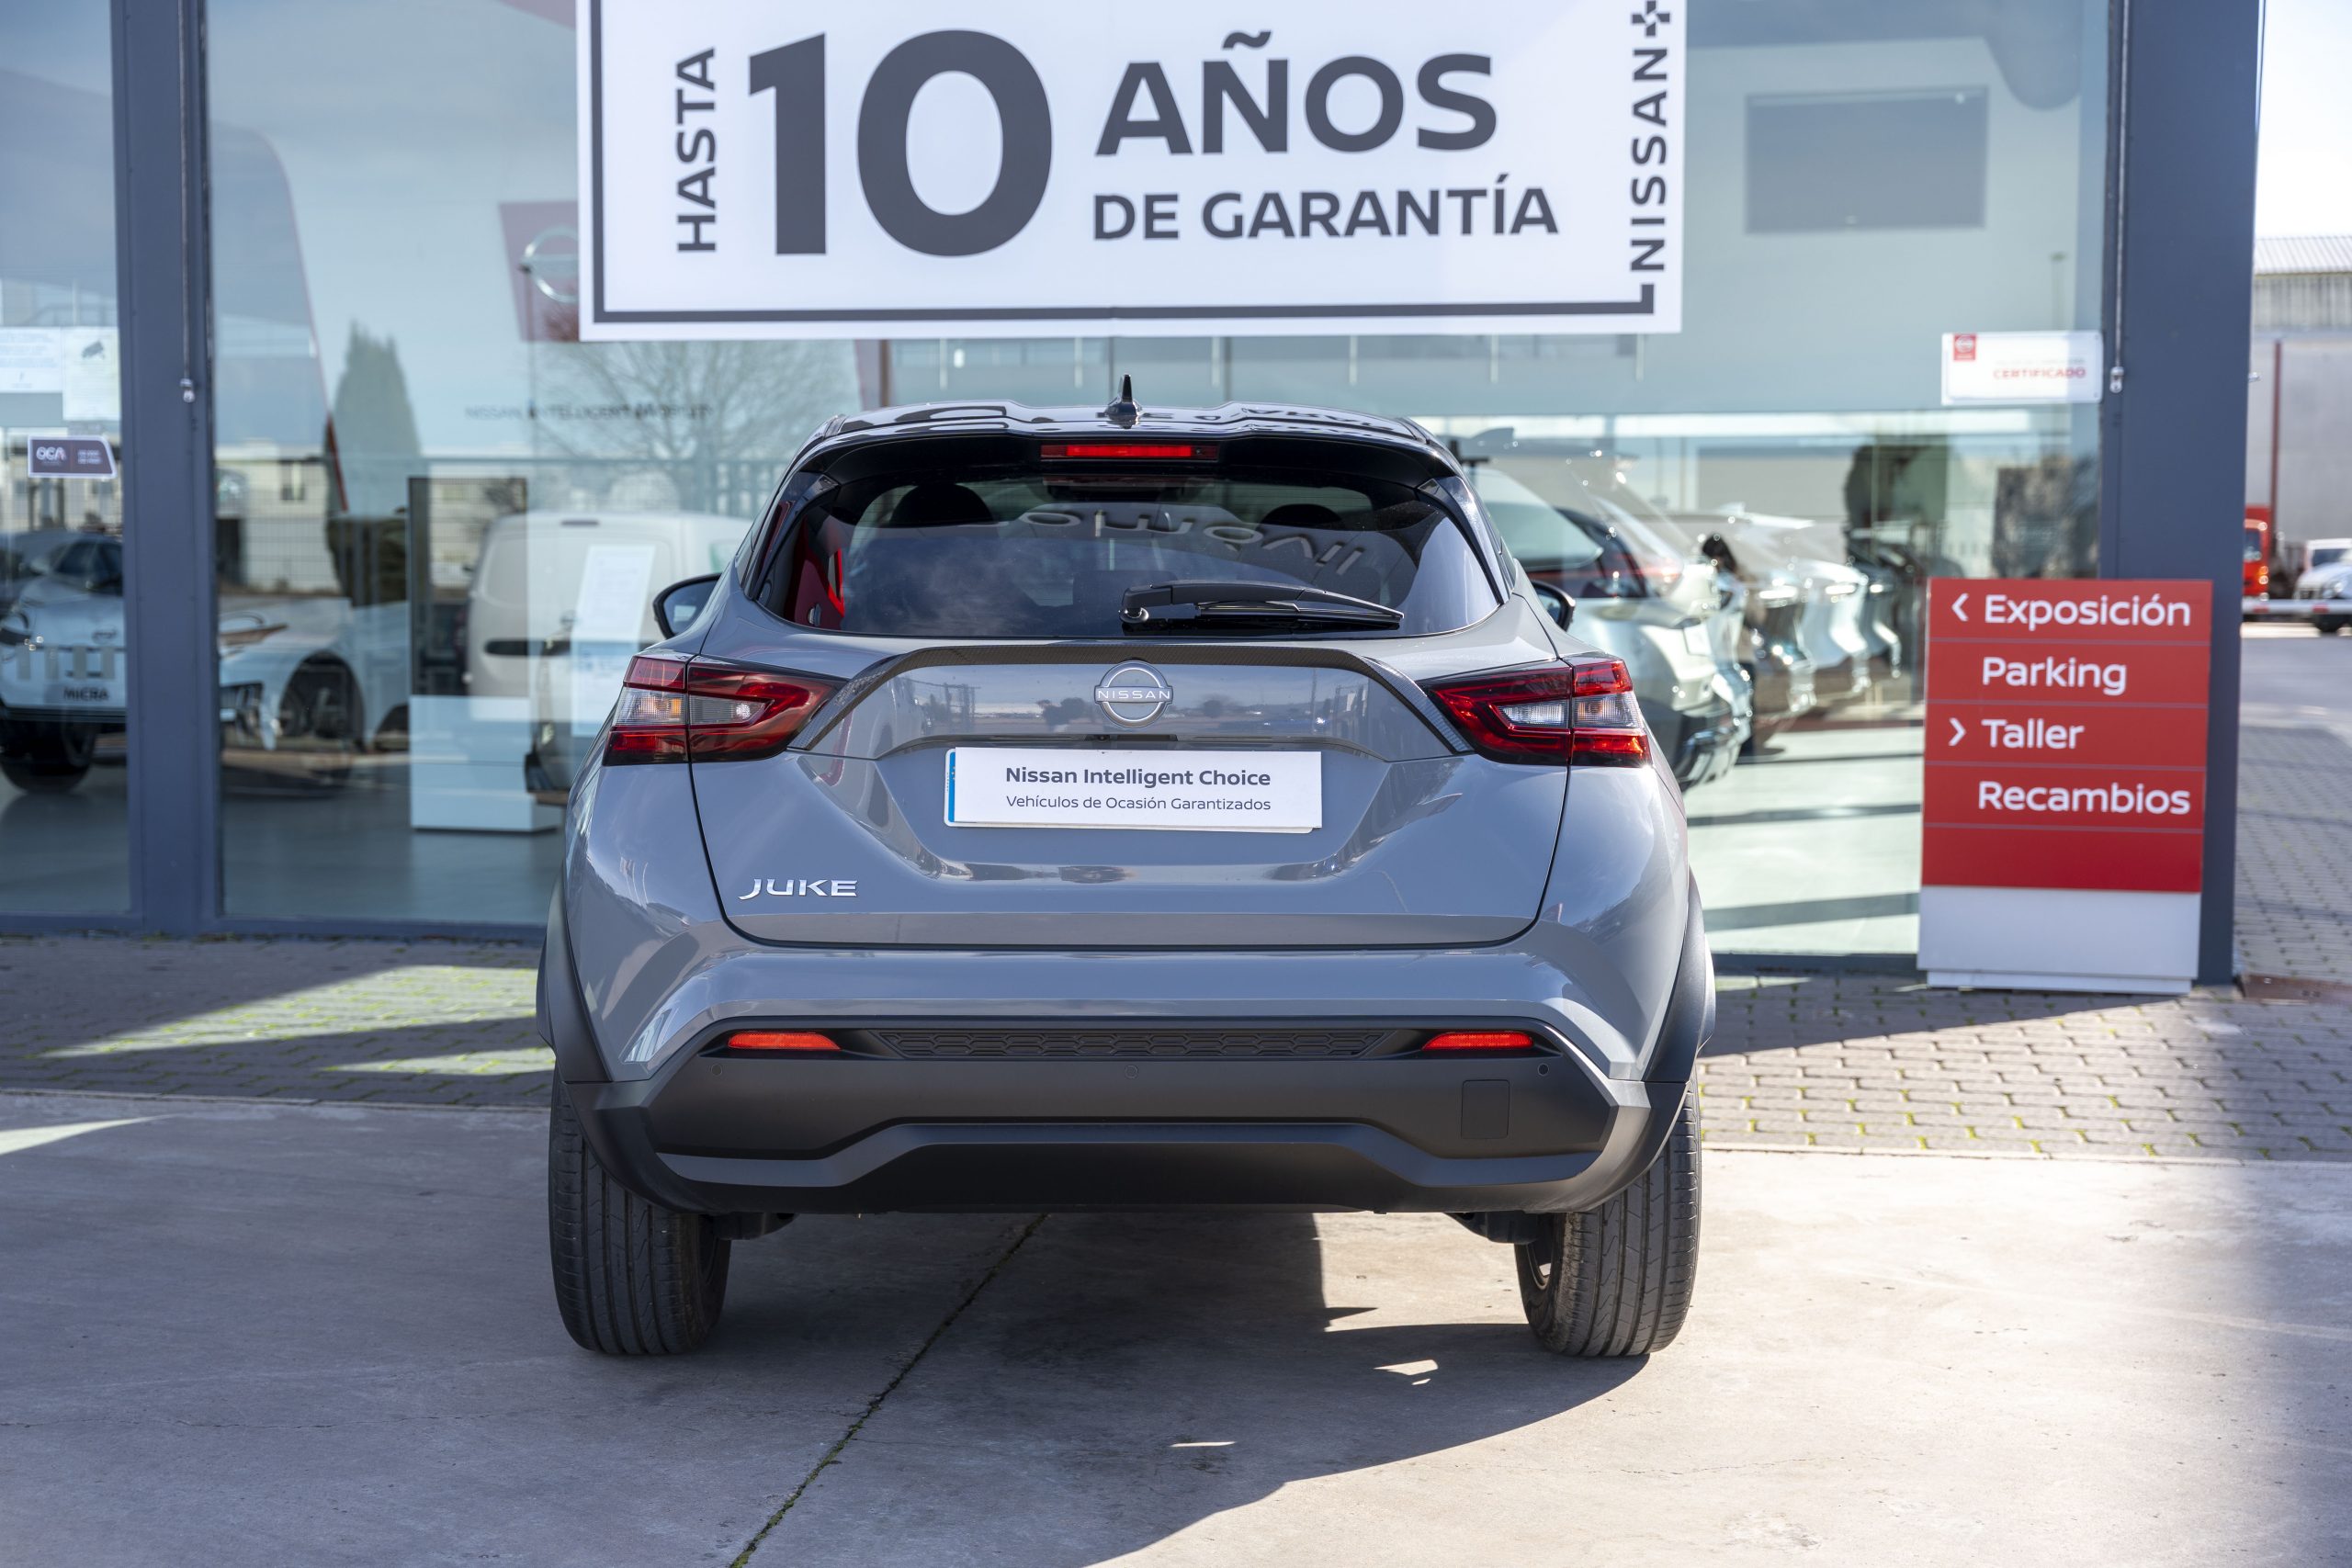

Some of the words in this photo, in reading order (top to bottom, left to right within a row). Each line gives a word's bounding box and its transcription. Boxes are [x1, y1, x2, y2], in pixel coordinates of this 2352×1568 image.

[1095, 30, 1497, 156] AÑOS
[676, 48, 716, 252] HASTA
[749, 29, 1053, 257] 10
[1094, 194, 1180, 241] DE
[1202, 174, 1559, 239] GARANTÍA
[1992, 367, 2087, 379] CERTIFICADO
[1985, 594, 2191, 632] Exposición
[1982, 657, 2127, 696] Parking
[1098, 690, 1170, 699] NISSAN
[1982, 718, 2085, 750] Taller
[1006, 767, 1078, 784] Nissan
[1084, 769, 1193, 789] Intelligent
[1199, 770, 1271, 786] Choice
[1006, 795, 1079, 808] Vehículos
[1083, 796, 1102, 808] de
[1106, 797, 1167, 809] Ocasión
[1170, 798, 1272, 810] Garantizados
[1978, 781, 2191, 815] Recambios
[738, 878, 858, 900] JUKE
